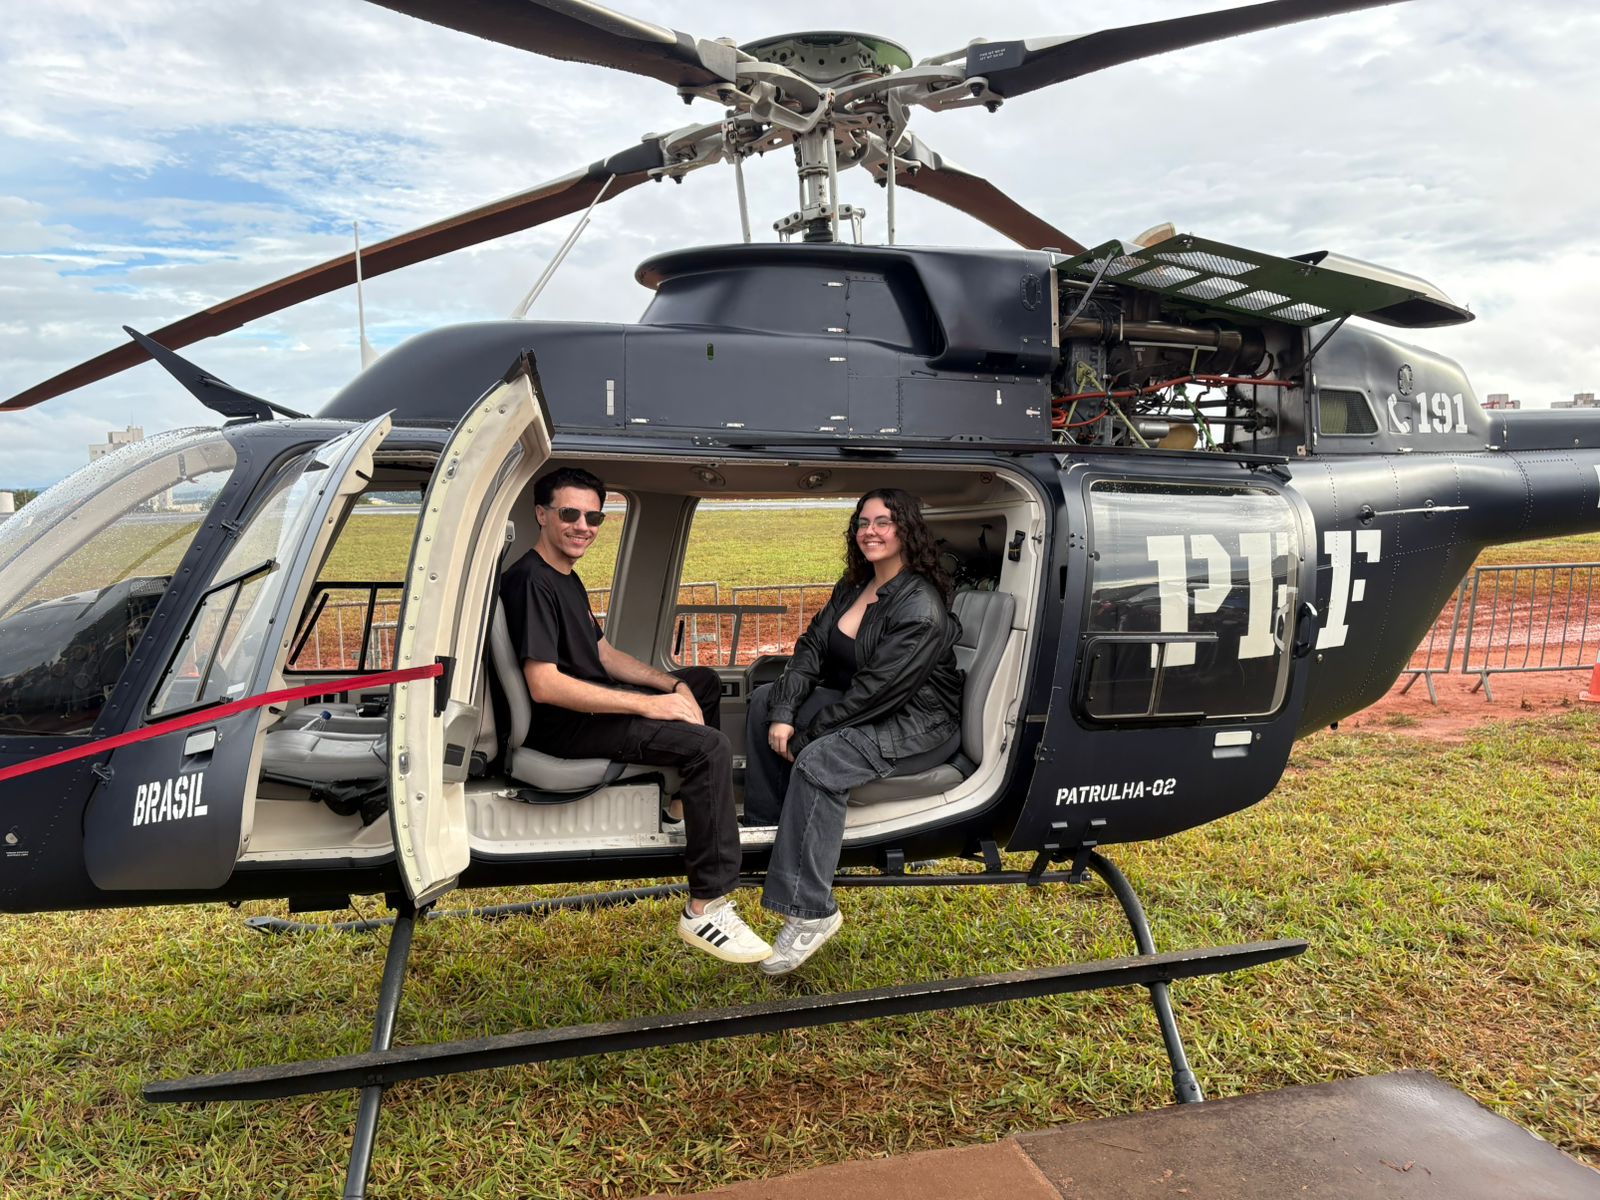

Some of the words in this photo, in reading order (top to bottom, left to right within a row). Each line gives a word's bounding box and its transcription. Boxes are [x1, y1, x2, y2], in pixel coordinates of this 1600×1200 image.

[1415, 392, 1468, 433] 191
[133, 772, 208, 826] BRASIL
[1055, 778, 1176, 806] PATRULHA-02
